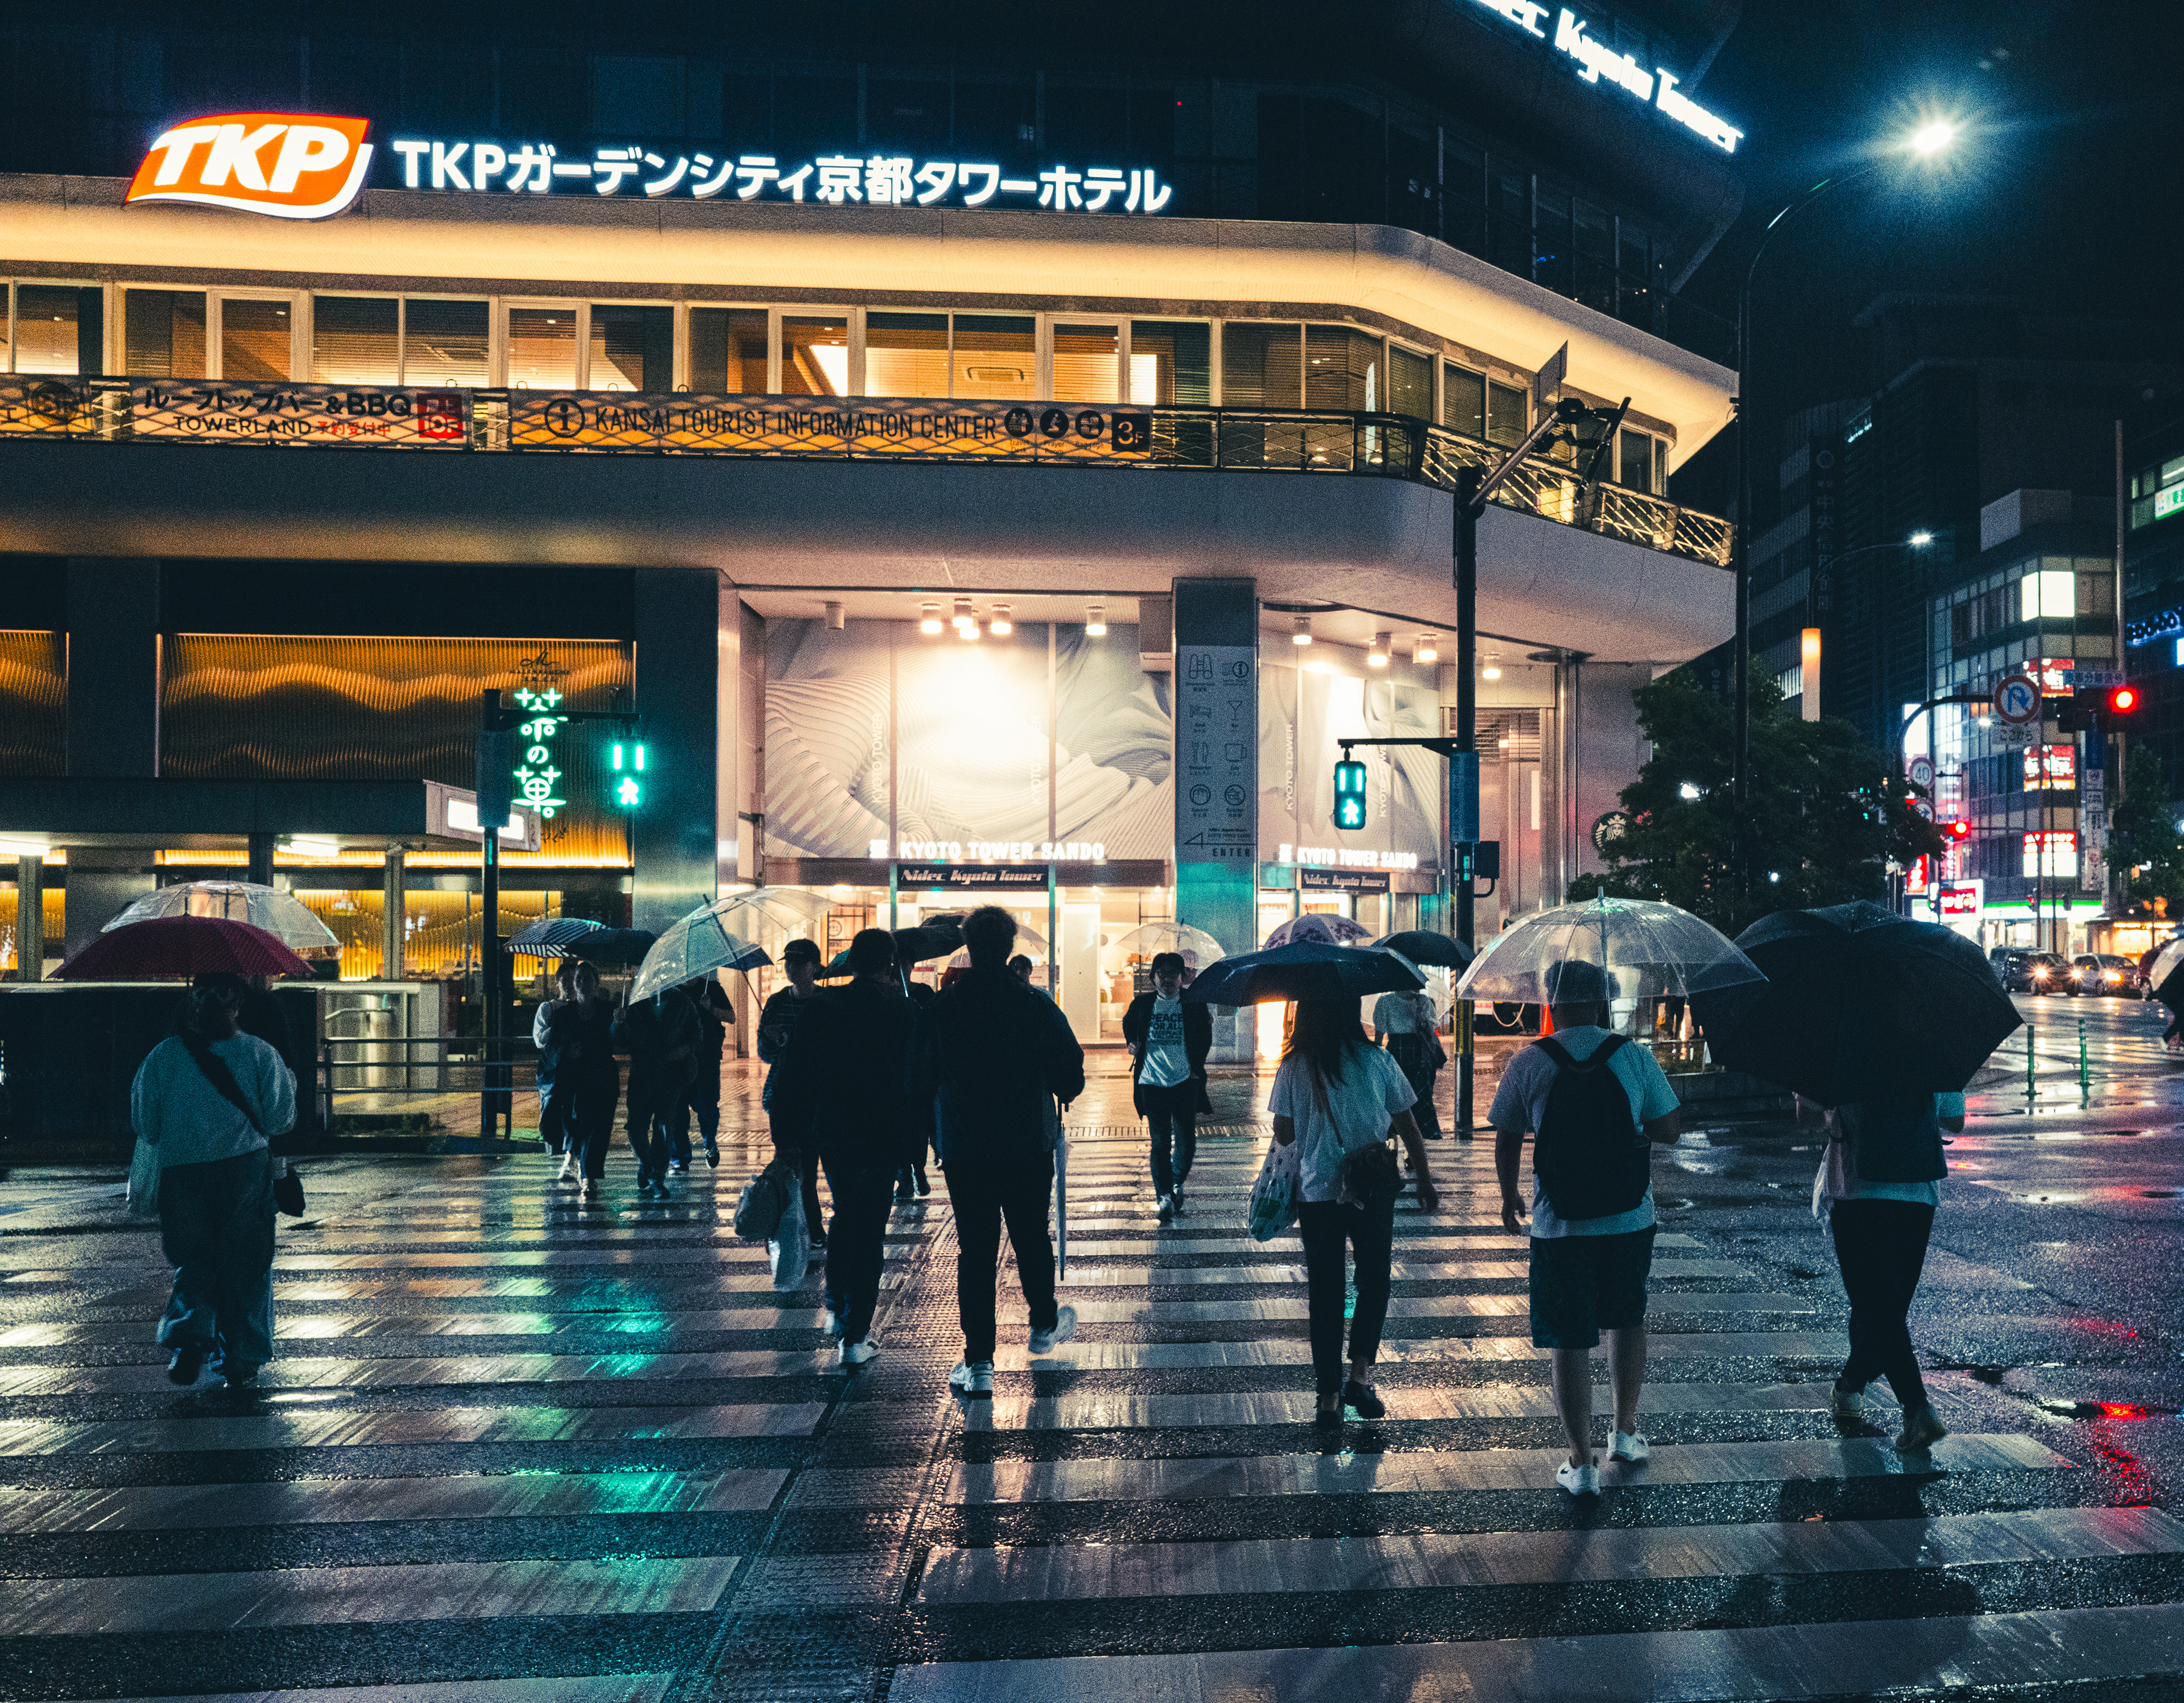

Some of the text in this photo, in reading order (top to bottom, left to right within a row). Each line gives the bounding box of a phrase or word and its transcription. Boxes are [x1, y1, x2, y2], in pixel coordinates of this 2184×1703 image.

[150, 123, 349, 193] TKP
[393, 140, 1171, 213] TKPガーデンシティ京都タワーホテル
[173, 416, 311, 435] TOWERLAND
[595, 408, 998, 440] KANSAI TOURIST INFORMATION CENTER
[1285, 724, 1294, 766] TOWER
[872, 713, 883, 803] KYOTO TOWER
[1915, 766, 1930, 782] 40
[900, 842, 1105, 861] KYOTO TOWER SANDO
[1213, 848, 1251, 857] ENTER
[1297, 847, 1417, 869] KYOTO TOWER SANDO
[901, 870, 1046, 885] Nidec Kyoto Tower
[1151, 1013, 1184, 1022] PEACE
